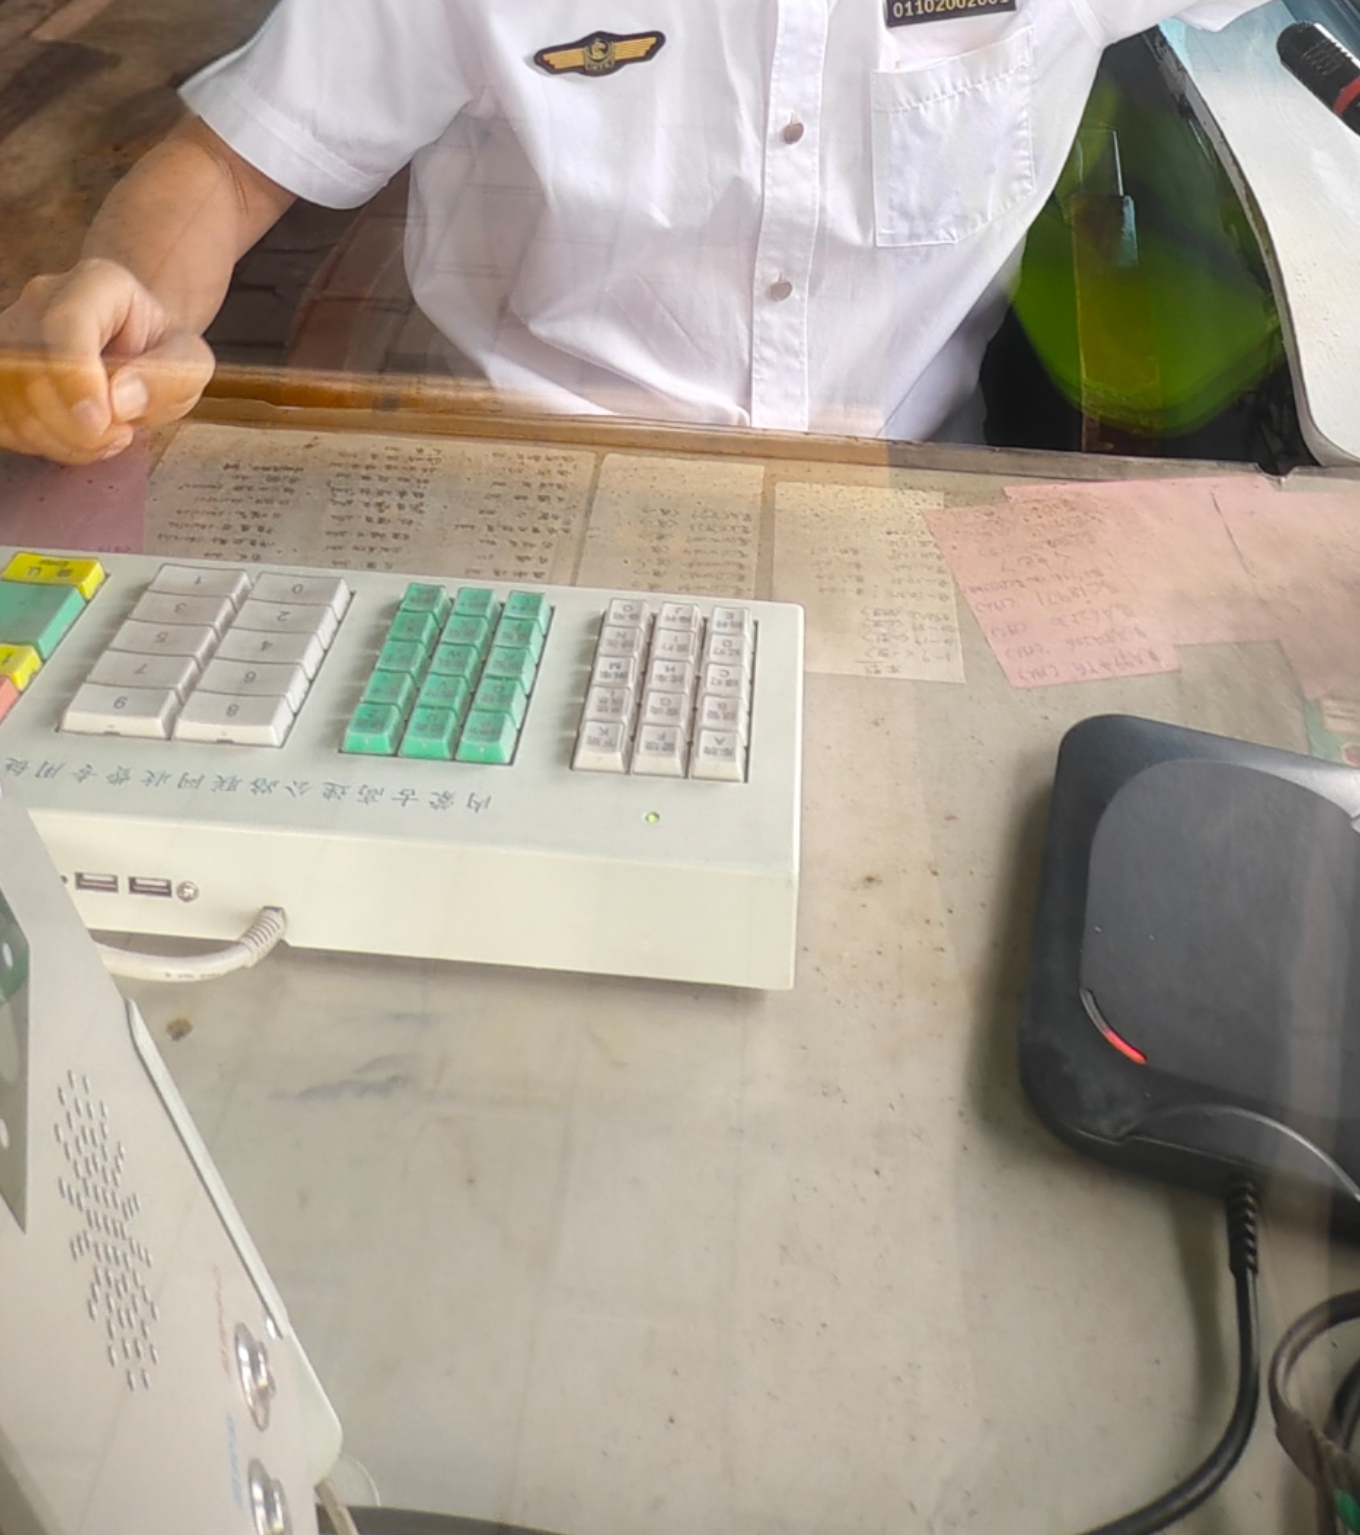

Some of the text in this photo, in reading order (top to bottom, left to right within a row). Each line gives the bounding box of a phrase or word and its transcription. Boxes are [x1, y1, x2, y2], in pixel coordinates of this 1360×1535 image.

[194, 575, 203, 585] 1
[292, 583, 304, 594] 0
[174, 602, 187, 614] 3
[277, 610, 291, 622] 2
[155, 631, 169, 643] 5
[261, 639, 274, 652] 4
[134, 662, 148, 675] 7
[243, 670, 257, 684] 6
[112, 695, 128, 710] 9
[226, 704, 240, 717] 8
[2, 757, 493, 814] 内蒙古高速公路联网收费专用键
